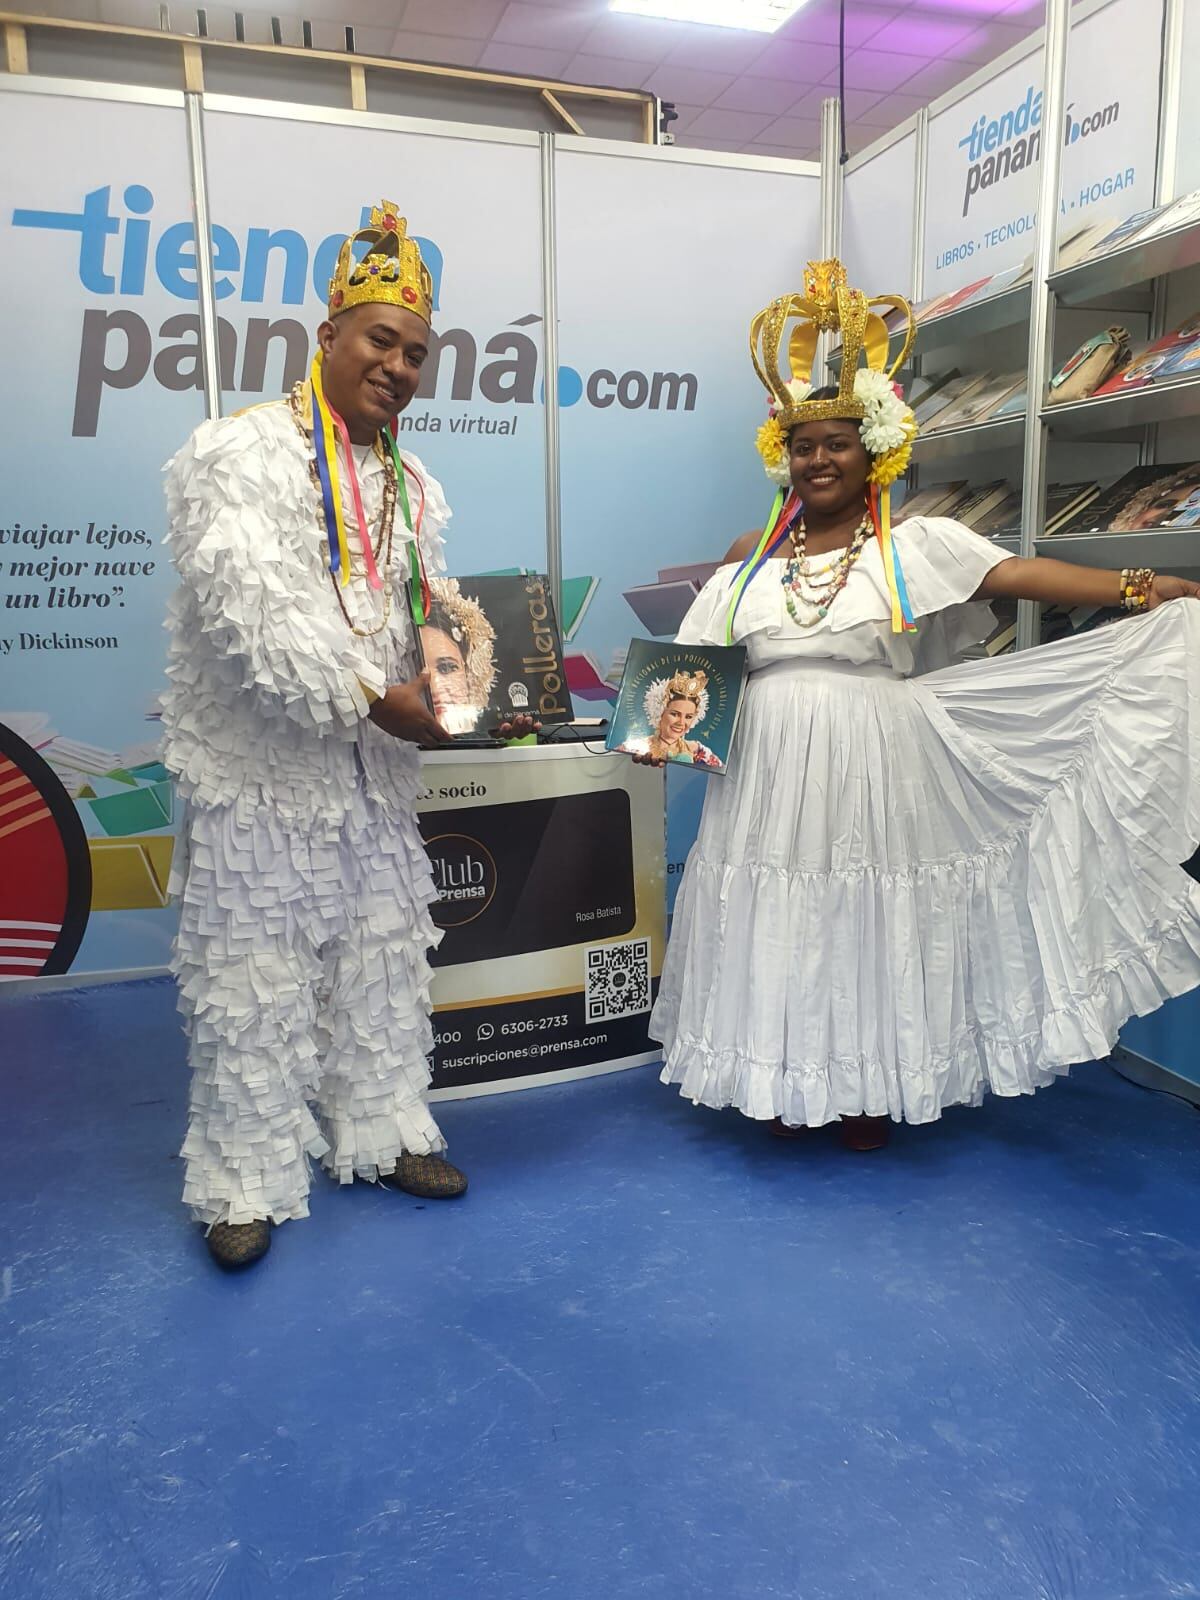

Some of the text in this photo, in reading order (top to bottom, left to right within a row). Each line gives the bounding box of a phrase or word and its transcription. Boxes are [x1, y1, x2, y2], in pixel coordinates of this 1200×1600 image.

[936, 240, 975, 270] LIBROS
[1080, 168, 1135, 208] HOGAR
[449, 414, 518, 436] virtual
[86, 522, 153, 550] lejos,
[9, 556, 89, 582] mejor
[94, 561, 156, 576] nave
[5, 594, 41, 608] un
[19, 632, 119, 650] Dickinson
[523, 577, 567, 715] polleras
[439, 781, 487, 799] socio
[575, 905, 622, 923] Rosa Batista
[501, 1014, 569, 1035] 6306-2733
[442, 1033, 608, 1069] suscripciones@prensa.com
